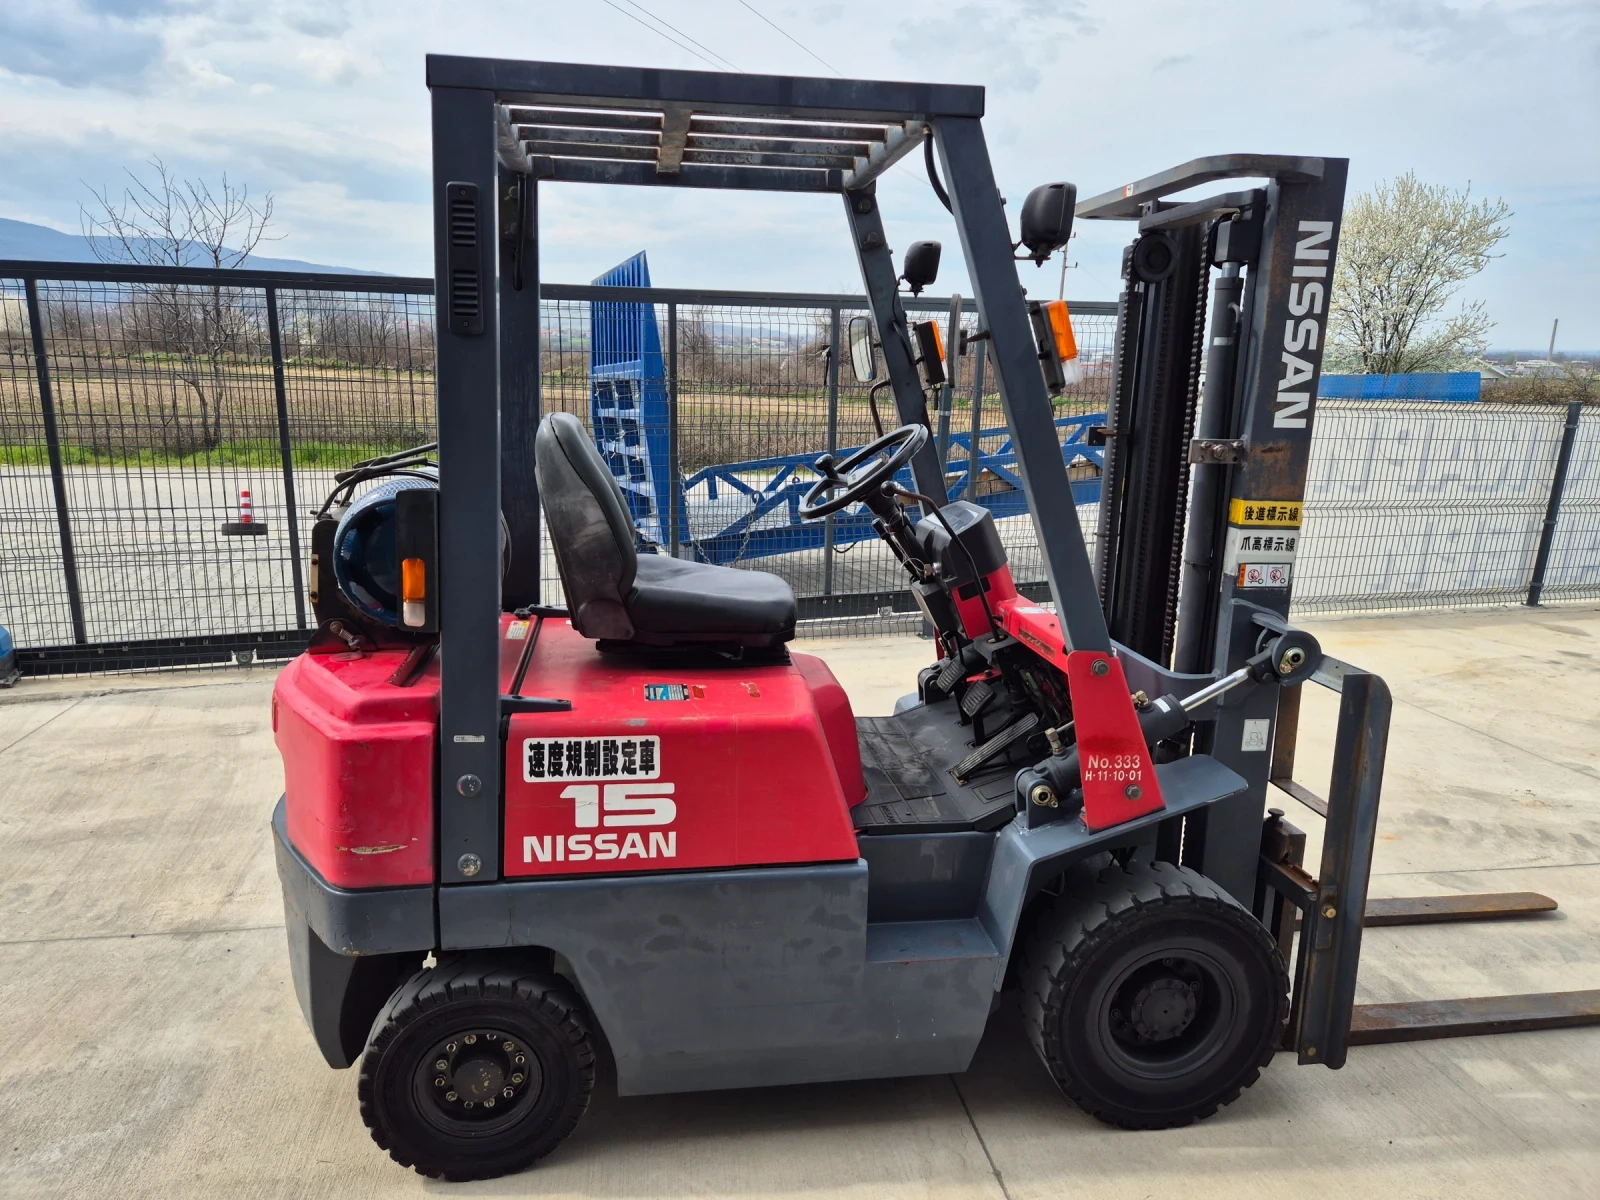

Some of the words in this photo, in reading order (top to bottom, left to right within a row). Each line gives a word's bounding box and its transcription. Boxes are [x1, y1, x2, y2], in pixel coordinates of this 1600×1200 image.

[1273, 220, 1333, 429] NISSAN
[1244, 506, 1299, 522] 後進標示線
[1240, 536, 1296, 552] 爪高標示線
[528, 739, 656, 778] 速度規制設定車
[1088, 755, 1140, 769] No.333
[559, 782, 677, 828] 15
[523, 831, 677, 863] NISSAN
